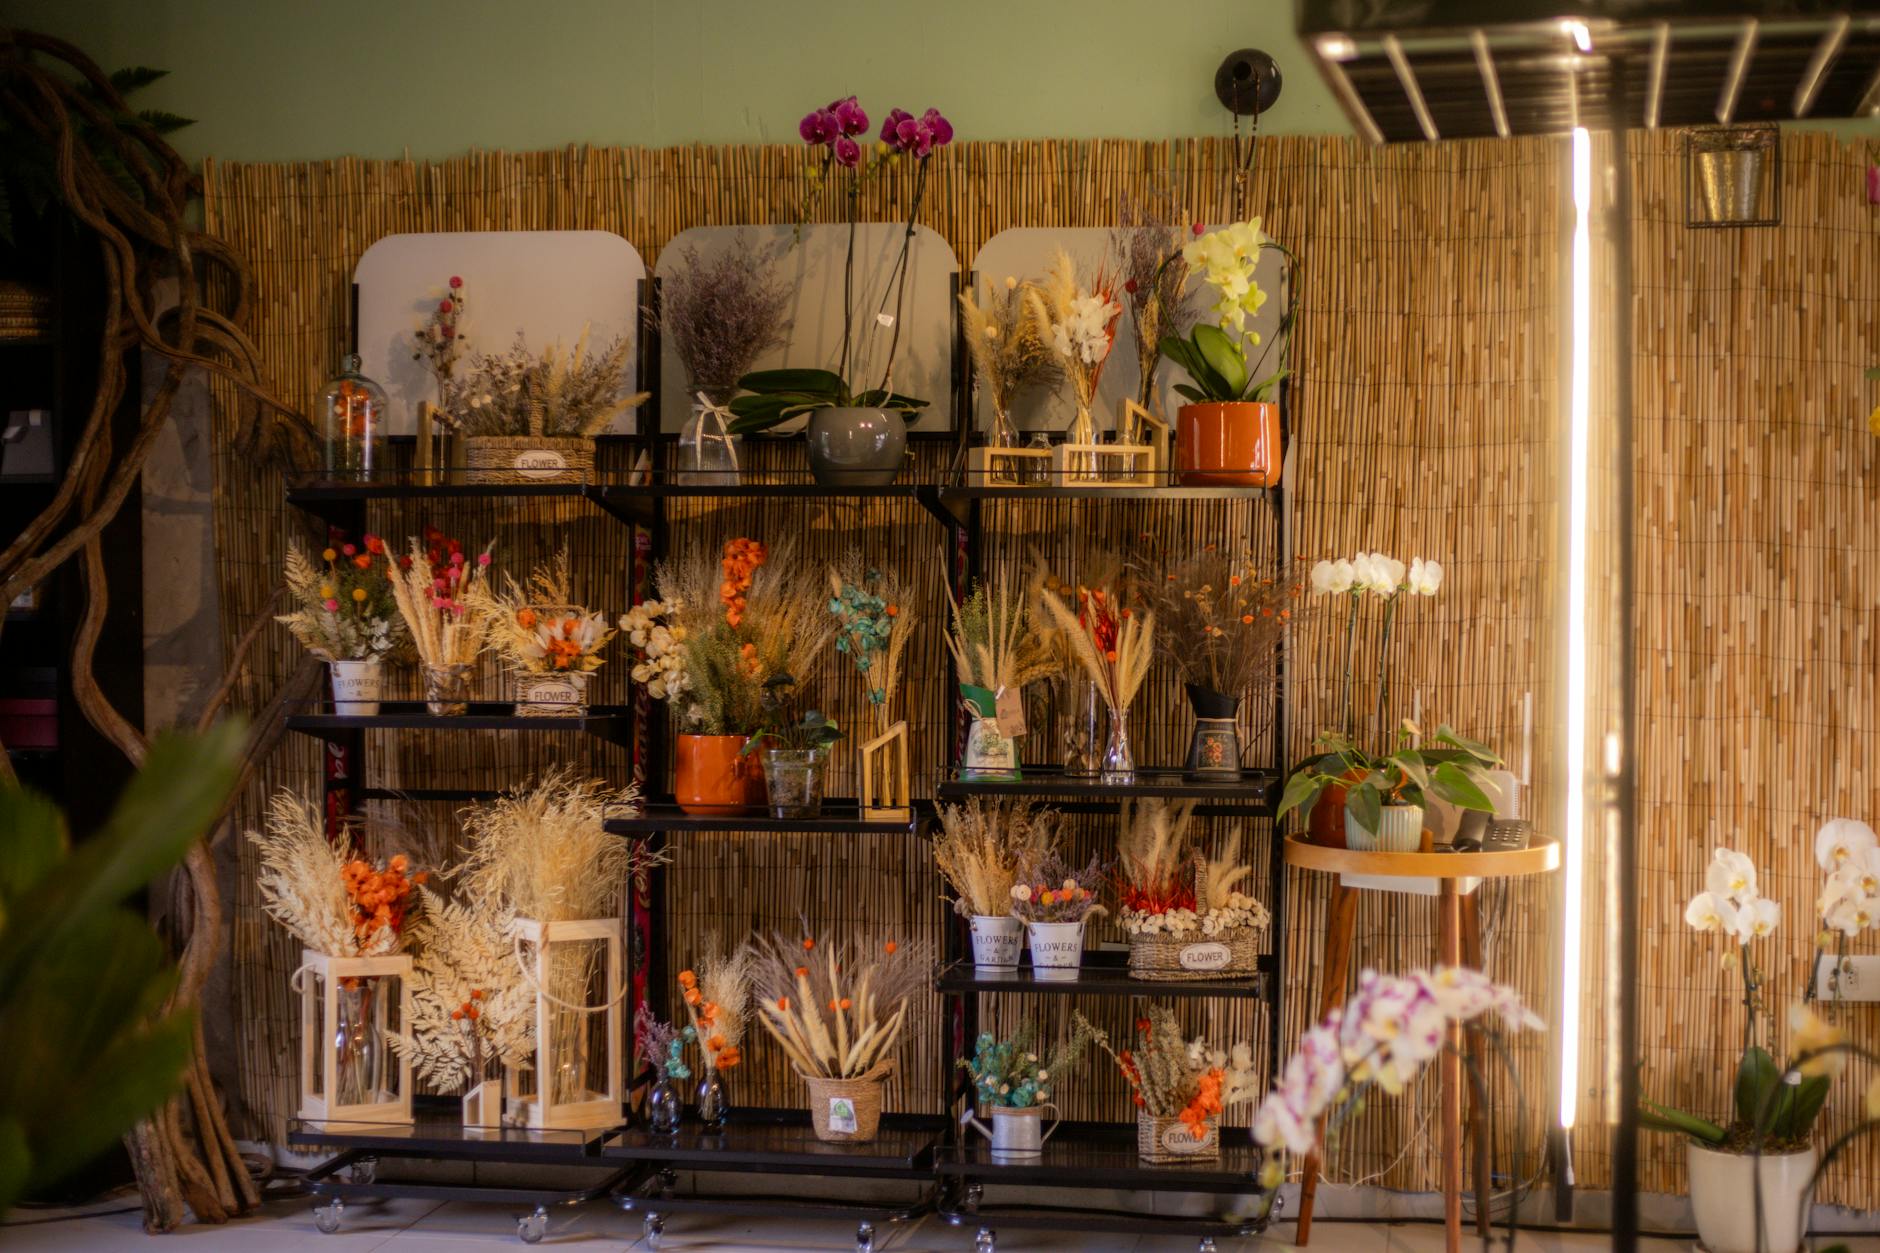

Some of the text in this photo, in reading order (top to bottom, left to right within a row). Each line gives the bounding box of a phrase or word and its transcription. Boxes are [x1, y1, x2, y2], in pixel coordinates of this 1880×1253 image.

[521, 459, 558, 468] FLOWER
[337, 679, 380, 688] FLOWERS
[534, 691, 572, 701] FLOWER
[976, 935, 1018, 945] FLOWERS
[1034, 942, 1078, 952] FLOWERS
[1186, 951, 1223, 962] FLOWER
